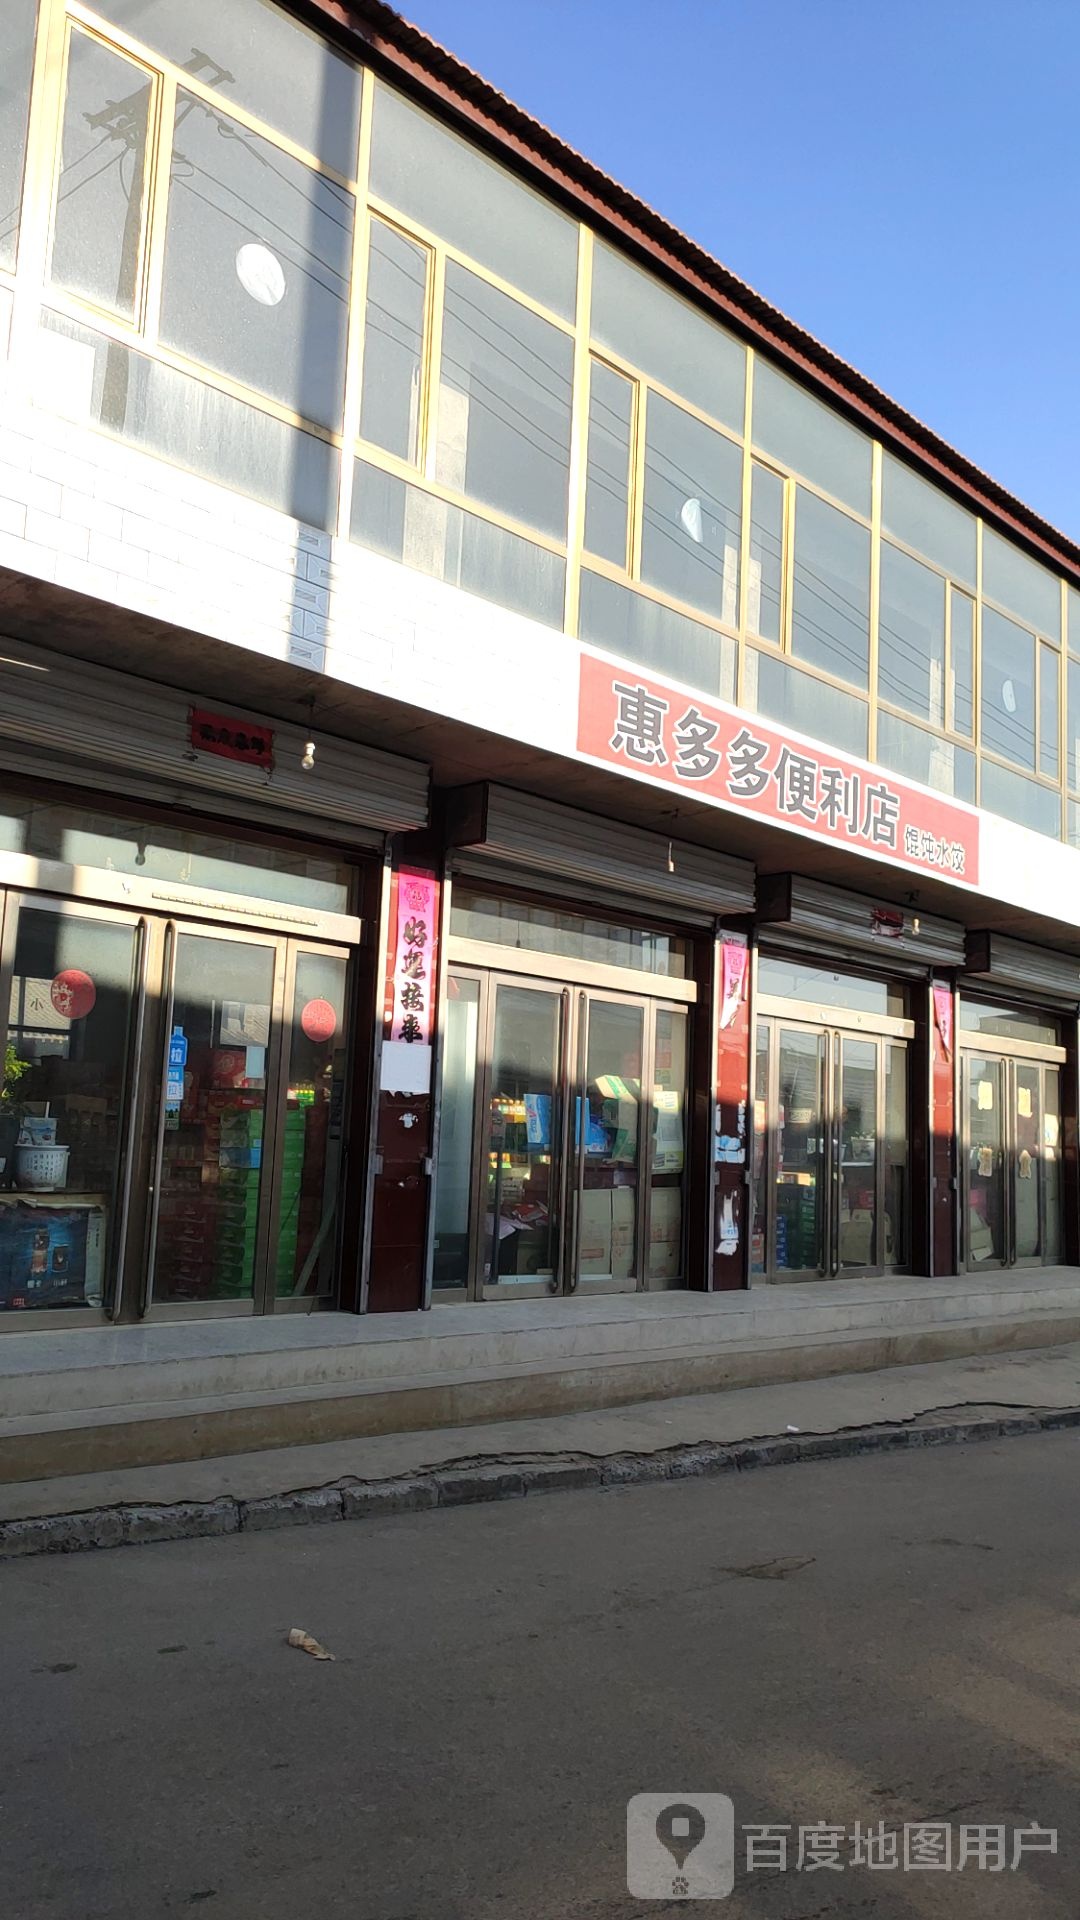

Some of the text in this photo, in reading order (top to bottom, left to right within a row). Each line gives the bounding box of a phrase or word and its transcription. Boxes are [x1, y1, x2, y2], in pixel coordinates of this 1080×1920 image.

[610, 681, 902, 850] 惠多多便利店
